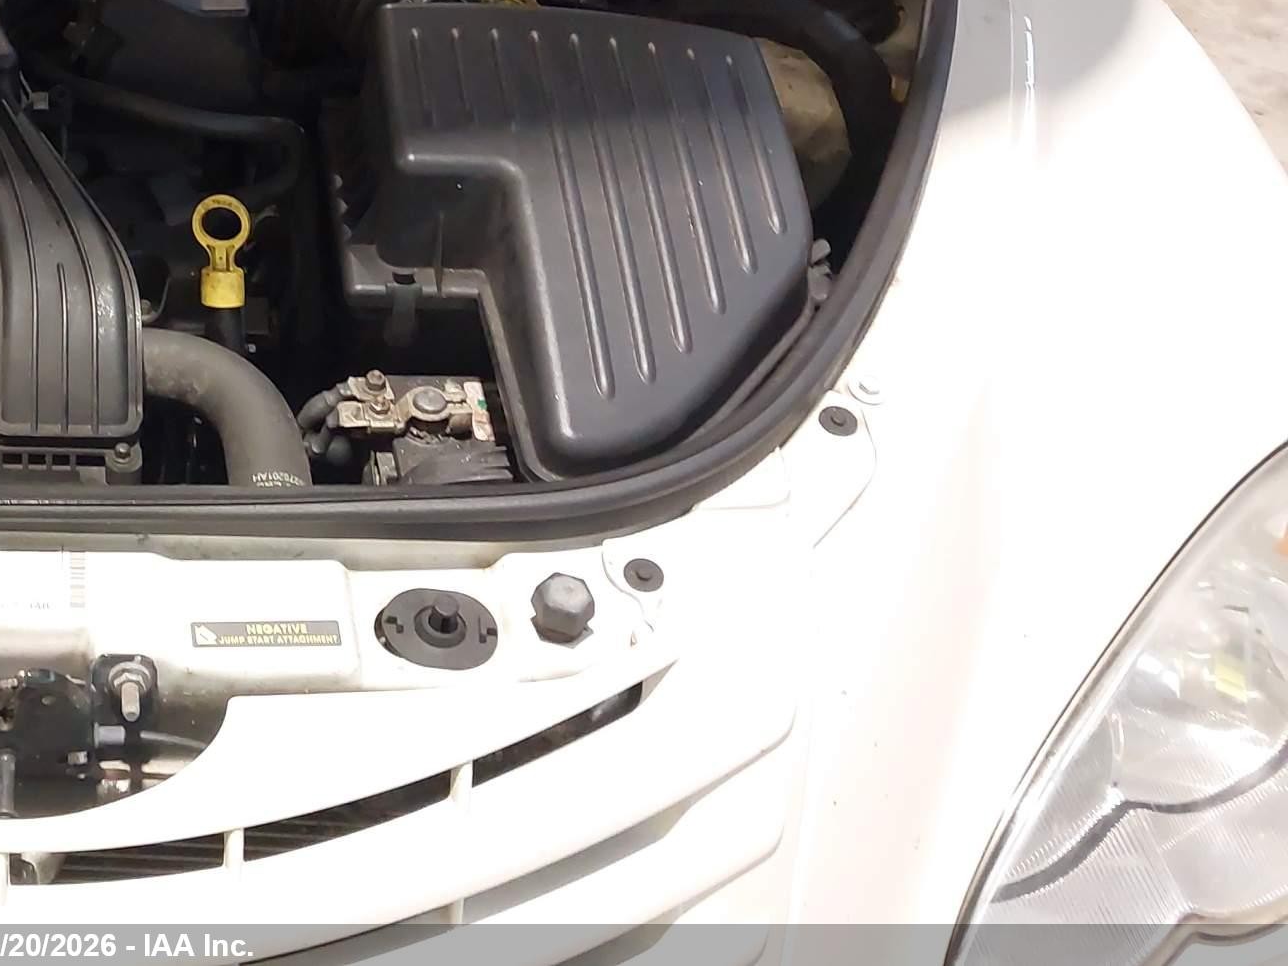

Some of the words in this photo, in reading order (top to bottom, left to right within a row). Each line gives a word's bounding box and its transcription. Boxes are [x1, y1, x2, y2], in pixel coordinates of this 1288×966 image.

[246, 624, 308, 635] NEGATIVE
[218, 635, 245, 645] JUMP
[247, 635, 275, 645] START
[277, 634, 338, 645] ATTACHMENT
